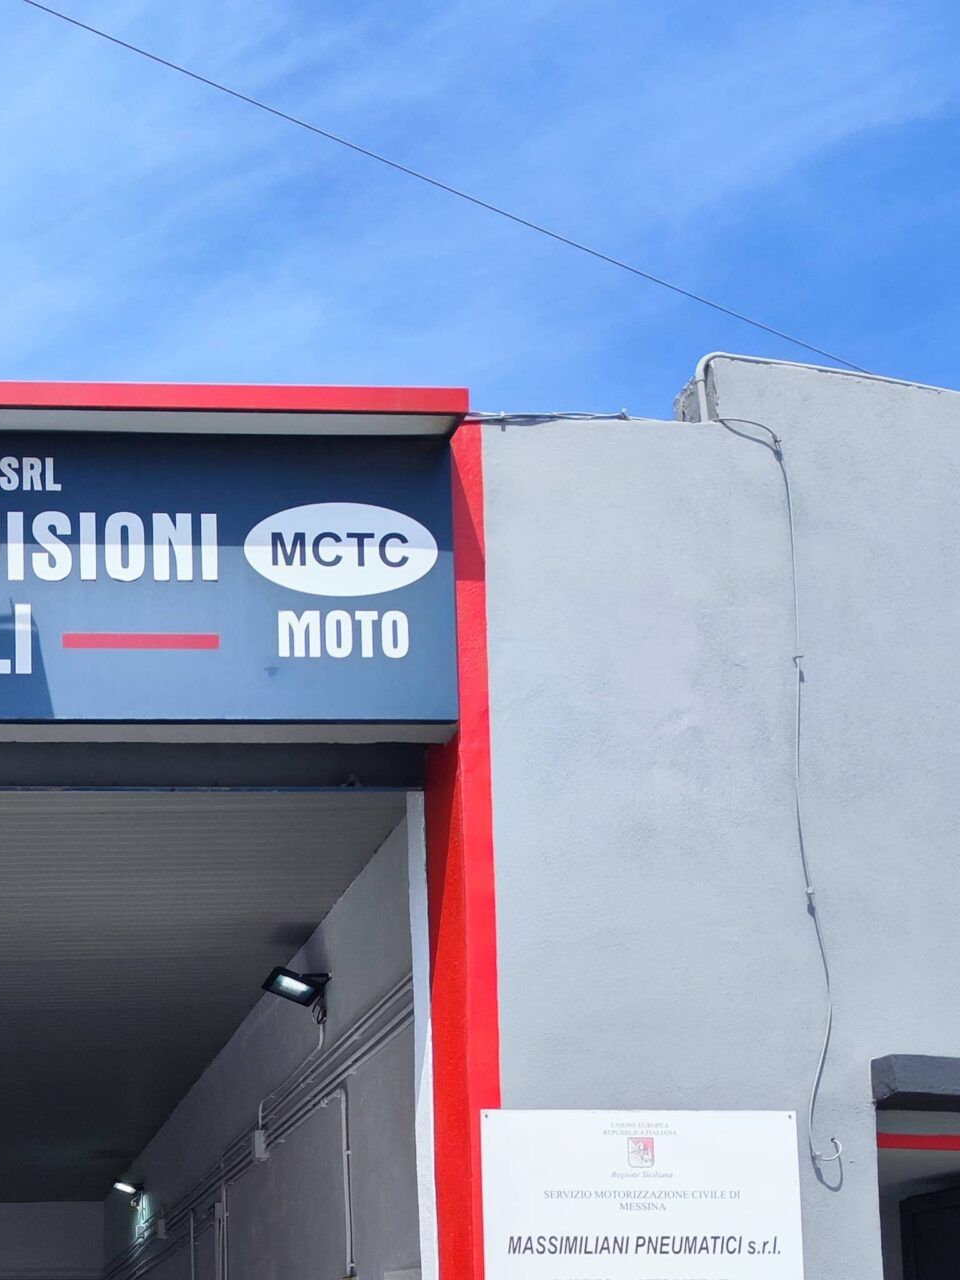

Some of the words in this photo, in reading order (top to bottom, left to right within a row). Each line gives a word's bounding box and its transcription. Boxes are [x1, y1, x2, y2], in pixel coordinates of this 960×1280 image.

[0, 456, 62, 492] SRL
[270, 531, 410, 568] MCTC
[277, 610, 410, 659] MOTO
[611, 1171, 640, 1179] Regione
[543, 1190, 592, 1200] SERVIZIO
[594, 1190, 690, 1200] MOTORIZZAZIONE
[691, 1190, 726, 1200] CIVILE
[729, 1190, 741, 1200] DI
[619, 1202, 667, 1211] MESSINA
[508, 1236, 630, 1255] MASSIMILIANI
[635, 1236, 743, 1255] PNEUMATICI
[747, 1236, 782, 1255] s.r.l.
